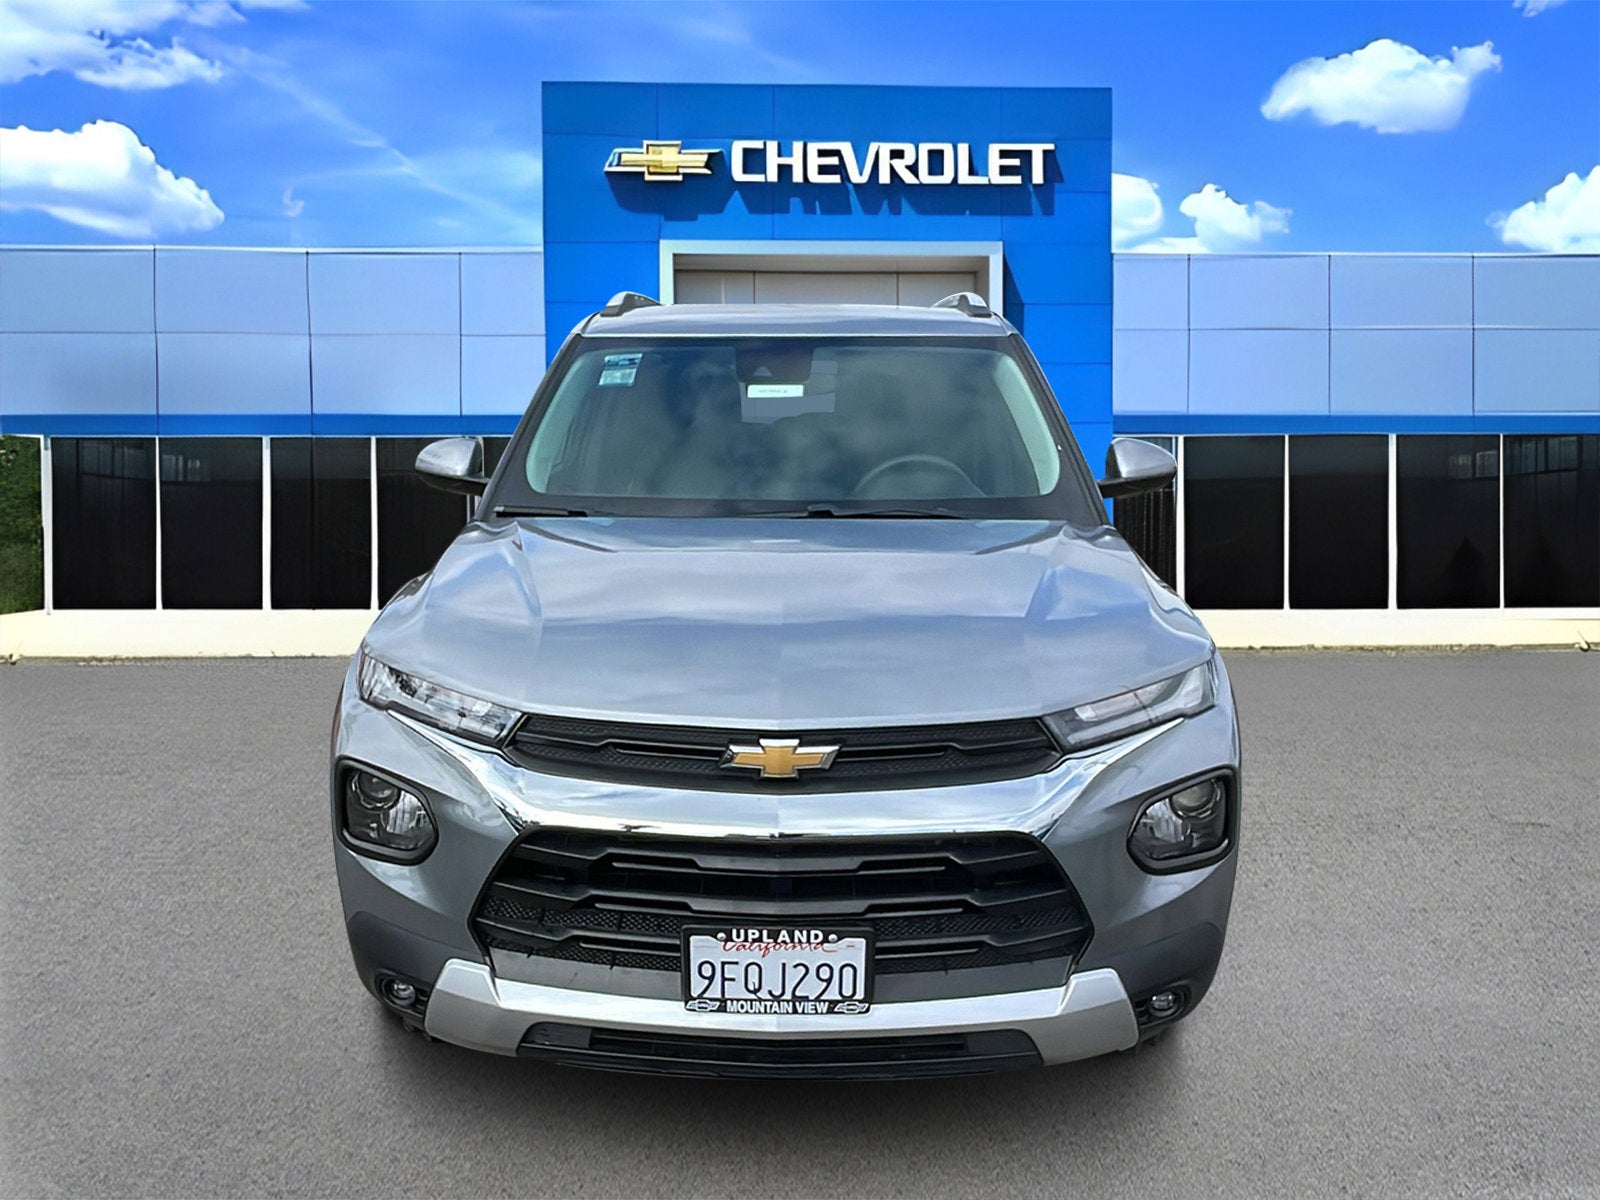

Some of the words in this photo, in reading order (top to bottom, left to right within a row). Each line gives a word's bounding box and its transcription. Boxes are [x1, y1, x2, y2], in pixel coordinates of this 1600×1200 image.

[731, 140, 1055, 184] CHEVROLET
[731, 928, 824, 943] UPLAND
[697, 960, 857, 1000] 9FQJ290
[726, 1000, 794, 1014] MOUNTAIN
[795, 1001, 829, 1014] VIEW
